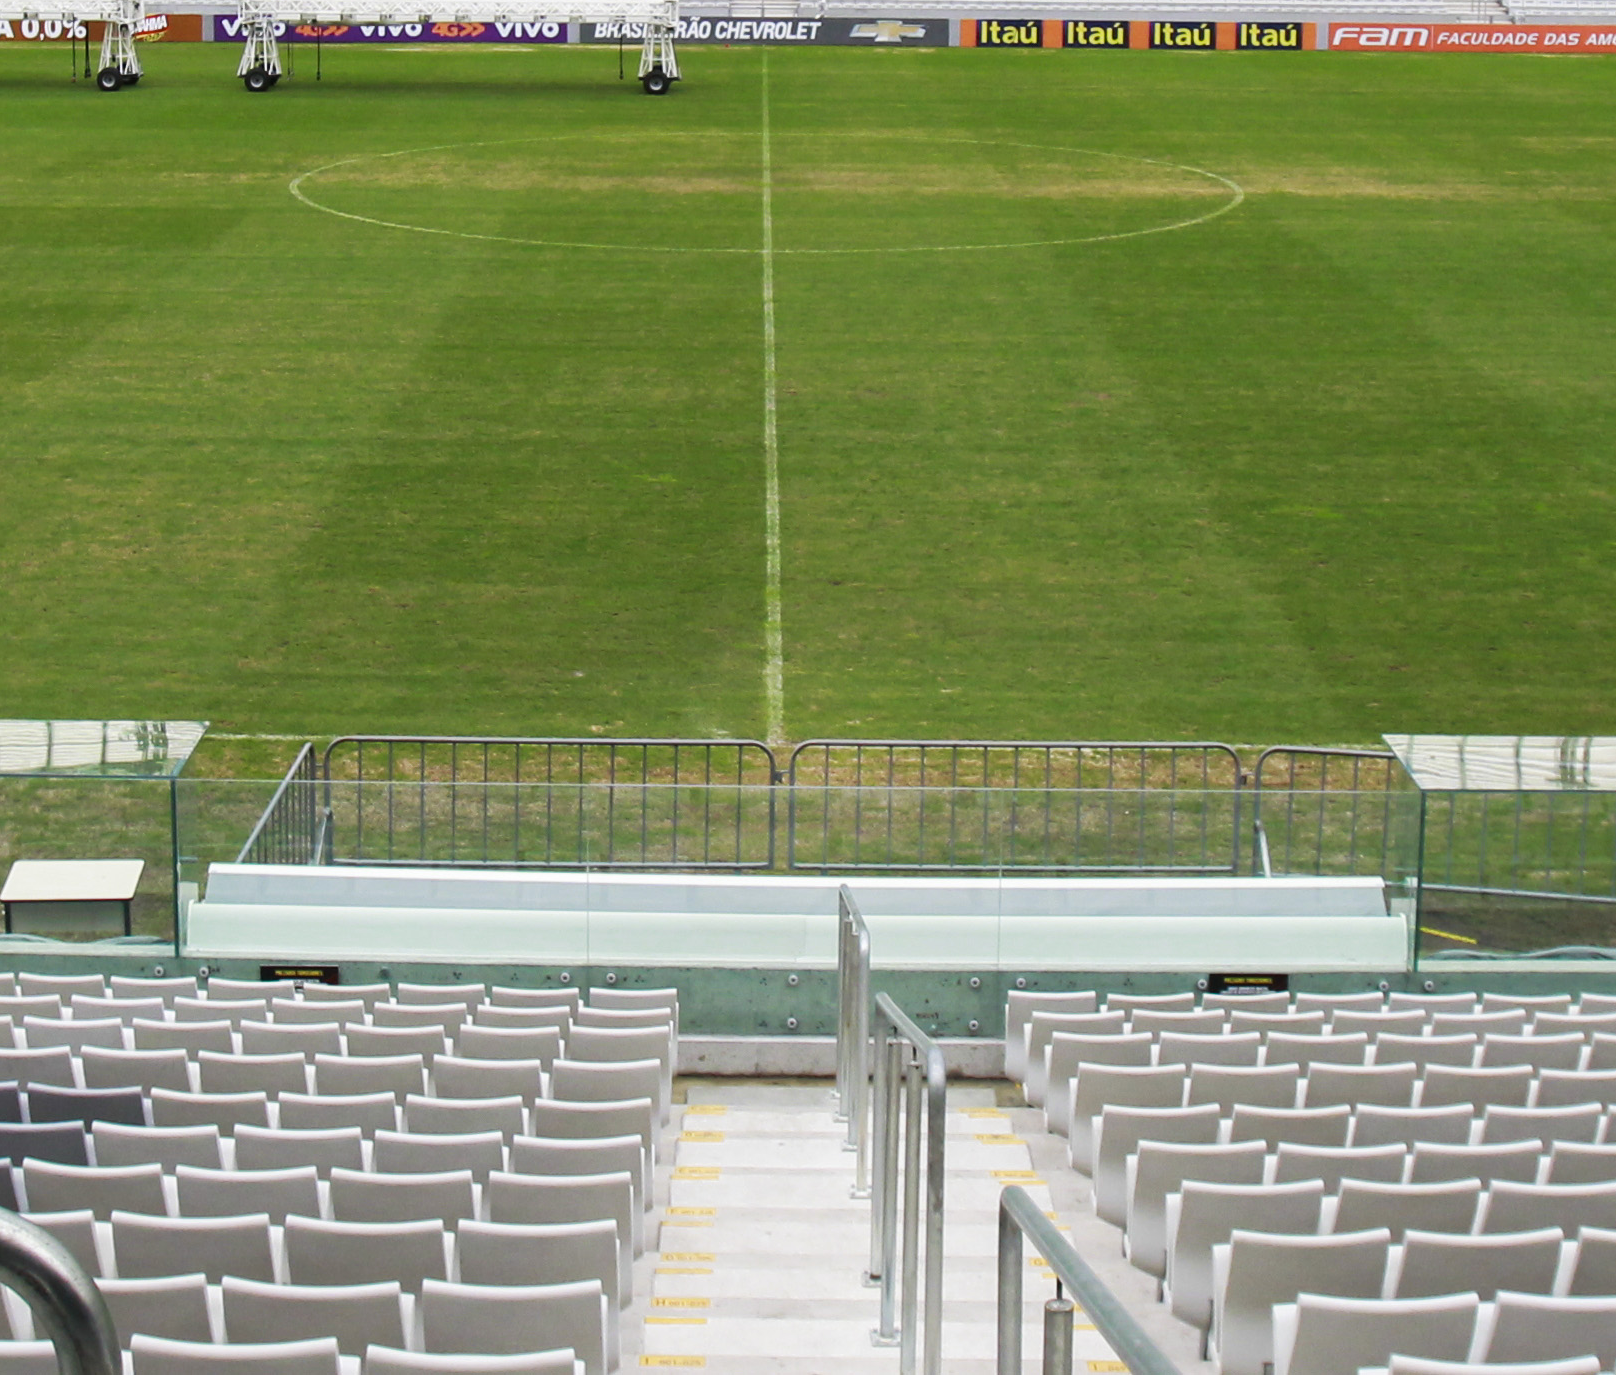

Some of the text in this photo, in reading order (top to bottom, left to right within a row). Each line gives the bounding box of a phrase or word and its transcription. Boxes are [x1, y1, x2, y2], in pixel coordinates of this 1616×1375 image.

[715, 21, 822, 40] CHEVROLET
[980, 20, 1038, 45] Itaú
[1067, 21, 1124, 46] Itaú
[1153, 22, 1211, 47] Itaú
[1240, 22, 1297, 47] Itaú
[1436, 32, 1539, 47] FACULDADE
[1544, 32, 1580, 46] DAS
